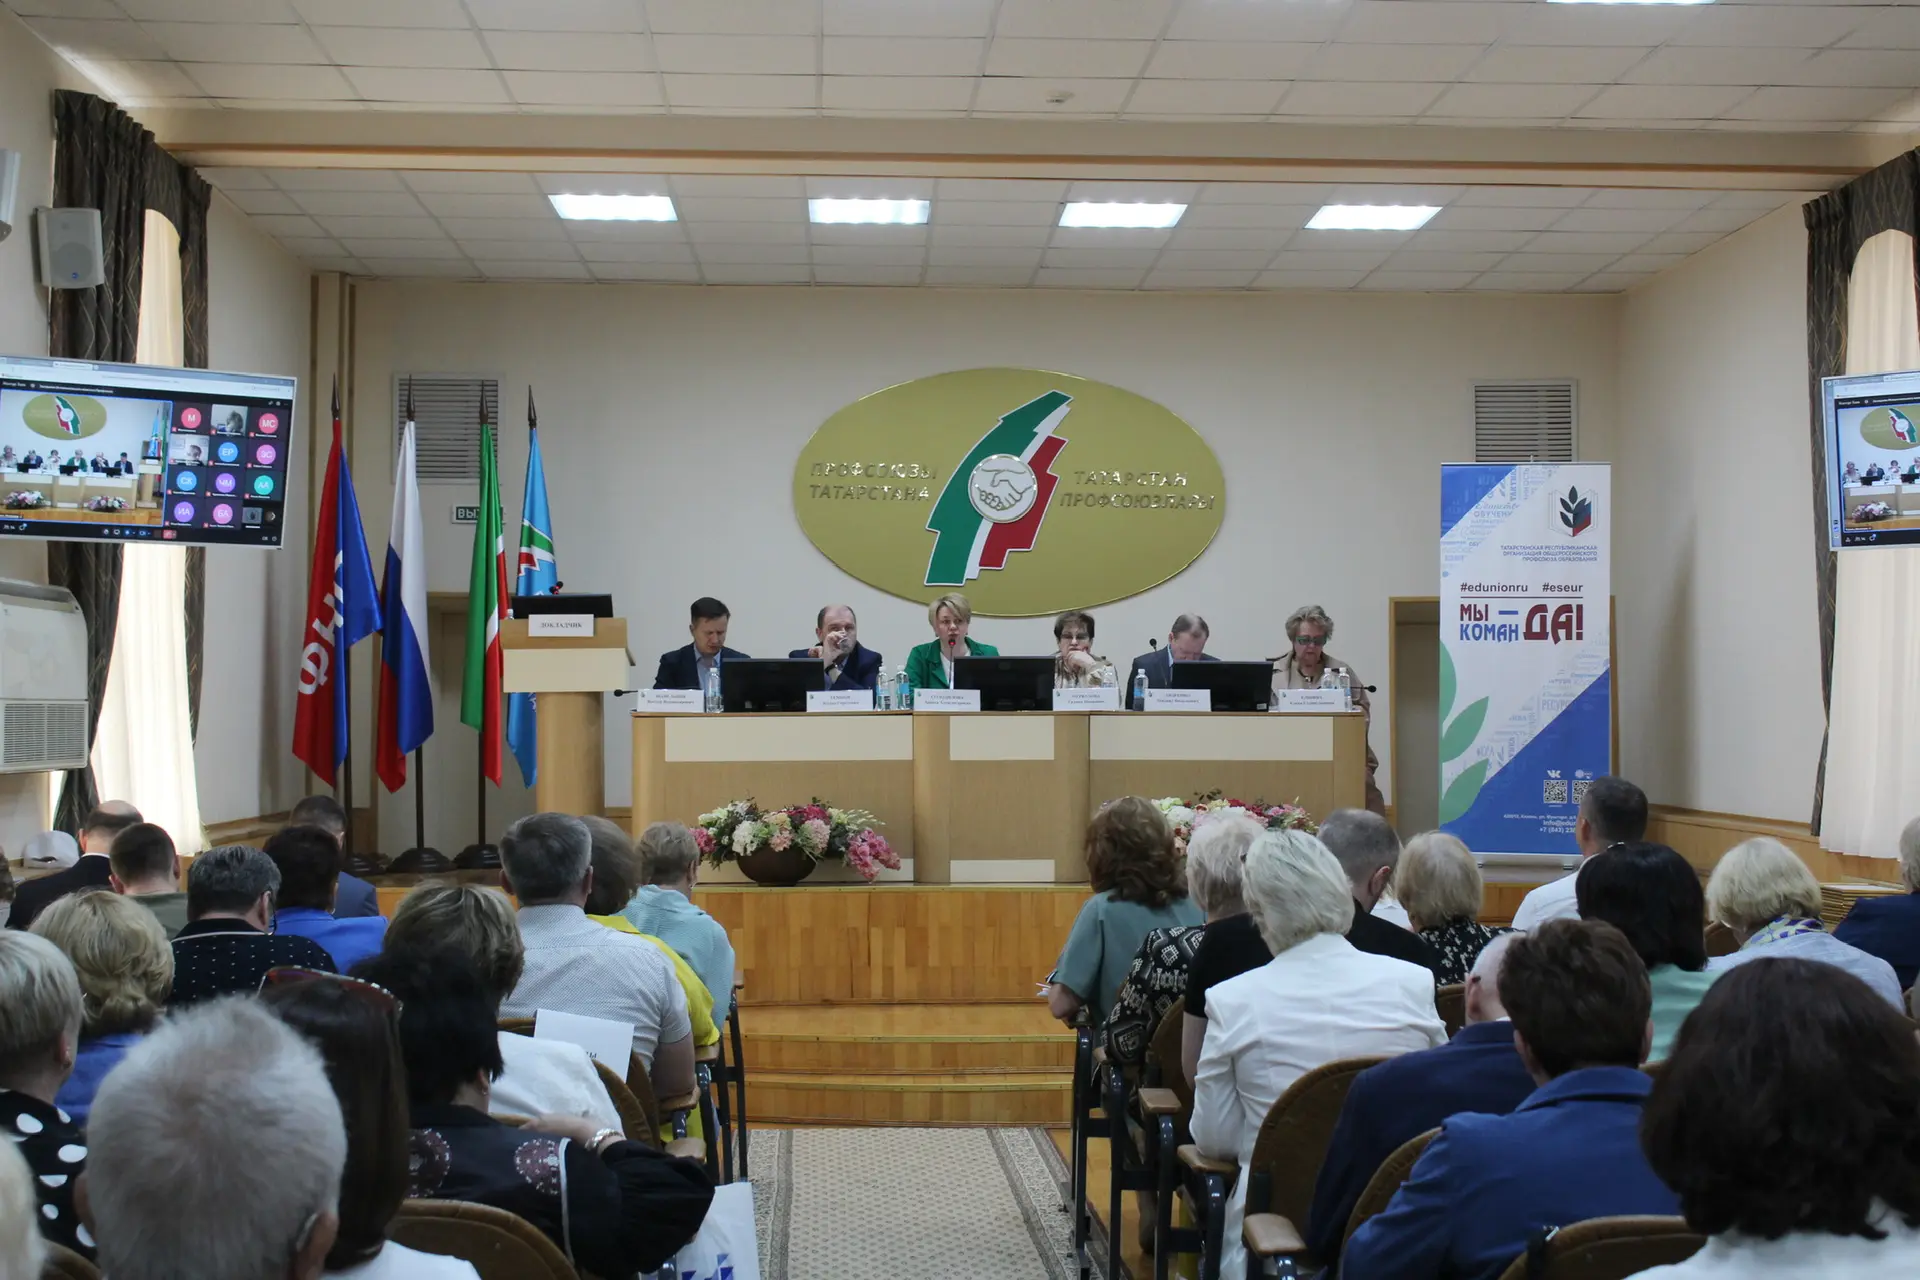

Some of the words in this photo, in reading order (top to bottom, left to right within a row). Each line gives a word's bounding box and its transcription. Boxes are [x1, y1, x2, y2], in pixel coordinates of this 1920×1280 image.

[810, 462, 938, 479] ПРОФСОЮЗЫ
[1074, 470, 1188, 487] ТАТАРСТАН
[809, 484, 929, 501] ТАТАРСТАНА
[1059, 492, 1216, 510] ПРОФСОЮЗЛАРЫ
[1460, 582, 1528, 592] #edunionru
[1542, 582, 1583, 592] #eseur
[1459, 603, 1489, 622] МЫ
